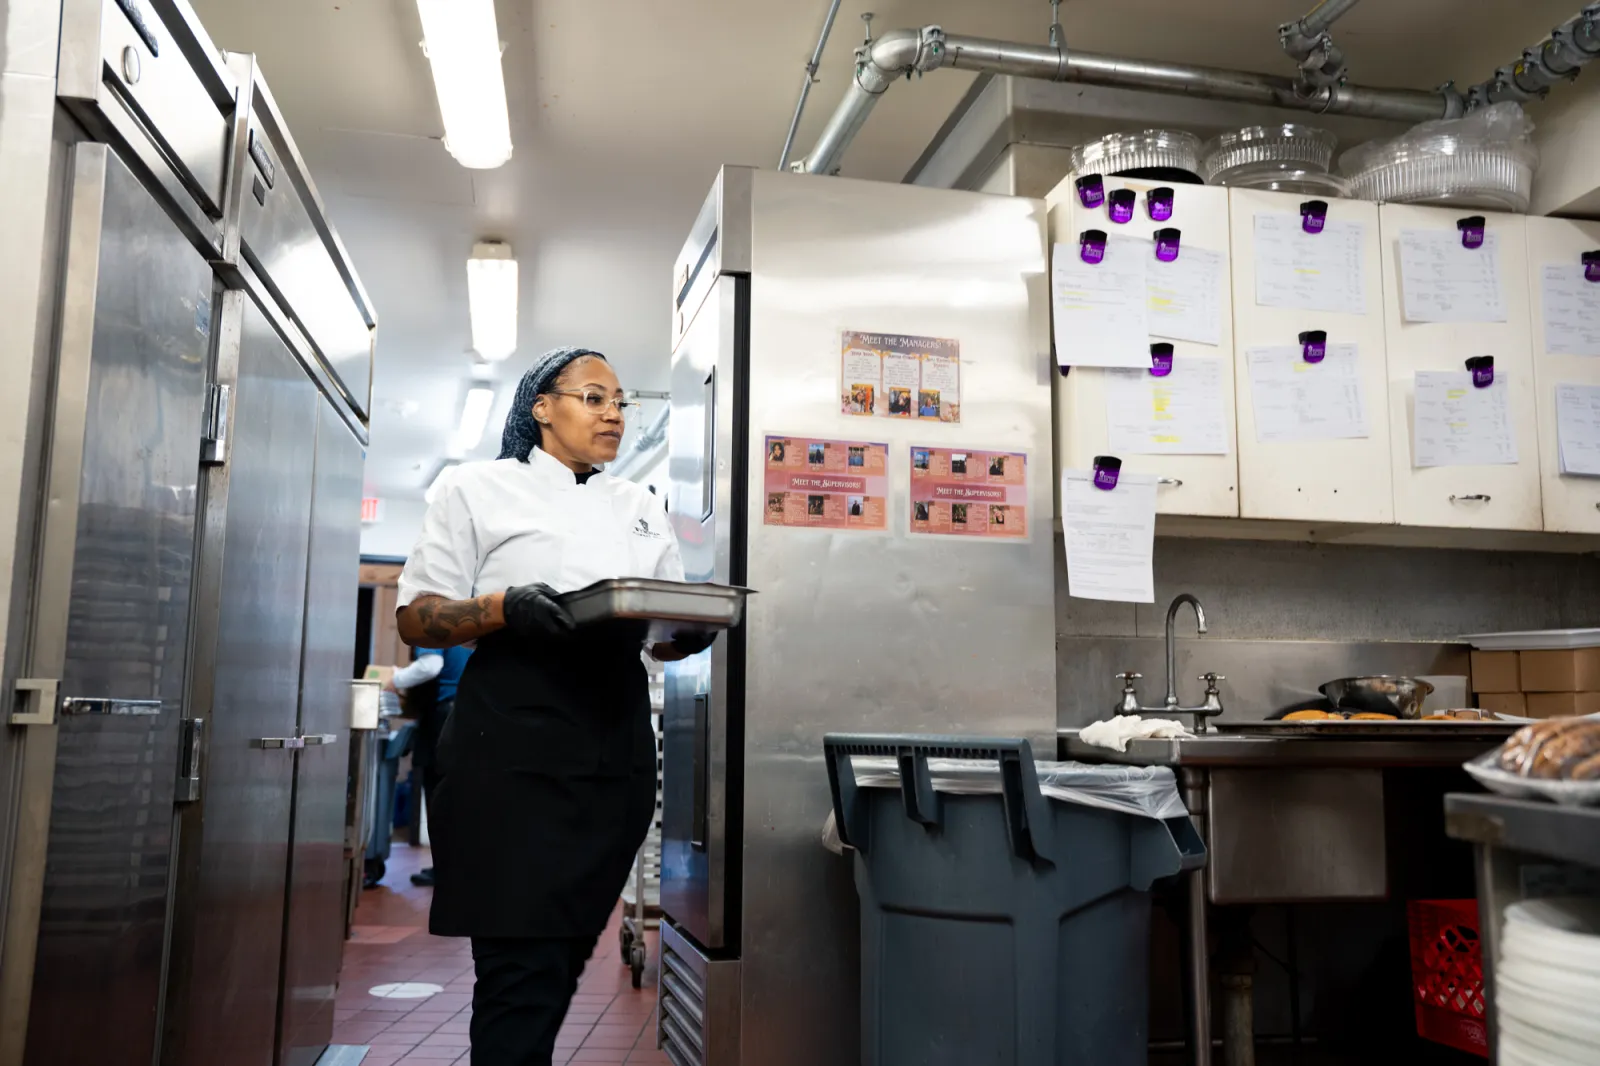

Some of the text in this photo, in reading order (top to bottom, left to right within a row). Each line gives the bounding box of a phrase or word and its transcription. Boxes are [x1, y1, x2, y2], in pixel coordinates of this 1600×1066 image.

[884, 337, 898, 346] THE
[811, 479, 821, 487] THE
[954, 488, 964, 496] THE
